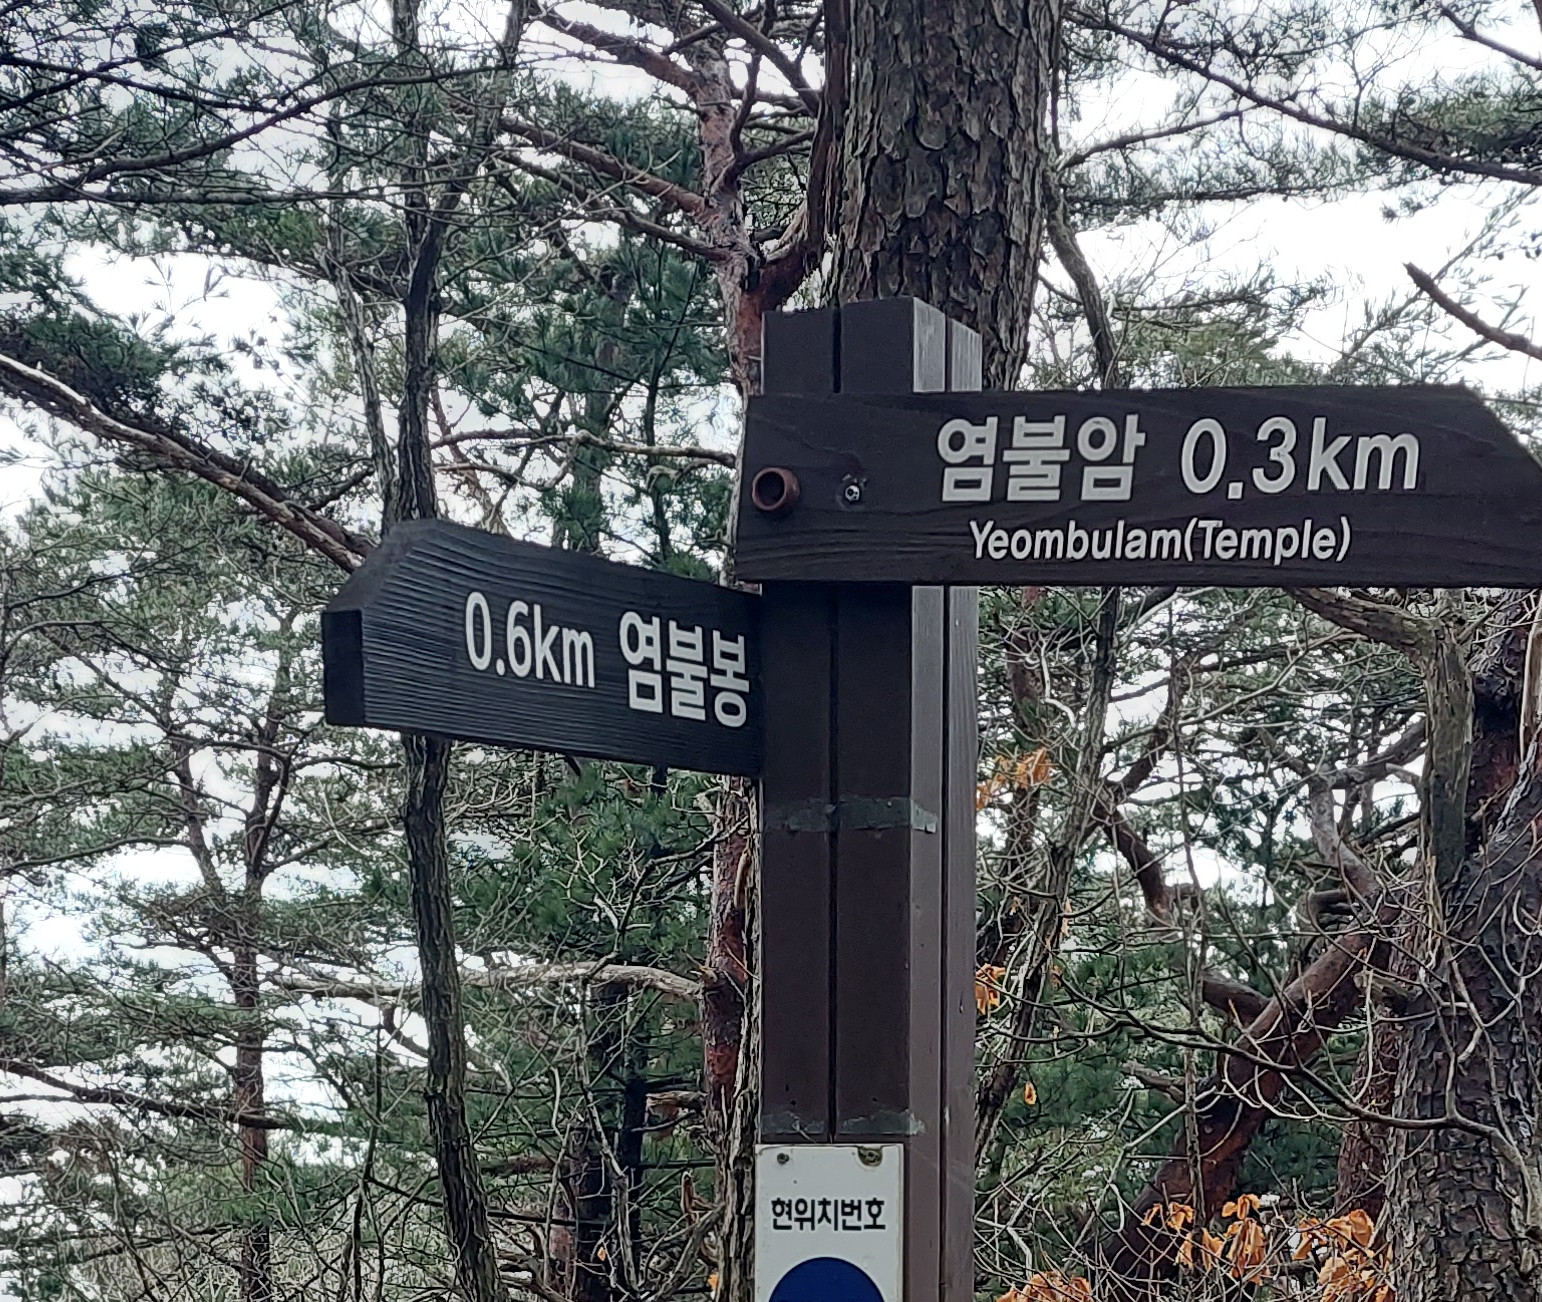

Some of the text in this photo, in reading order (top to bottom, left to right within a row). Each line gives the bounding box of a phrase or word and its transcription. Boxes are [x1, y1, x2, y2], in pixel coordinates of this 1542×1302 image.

[937, 414, 1420, 502] 염불암 0.3km
[969, 516, 1351, 566] Yeombulam(Temple)
[464, 590, 750, 728] 0.6km 염불봉
[771, 1197, 886, 1232] 현위치번호
